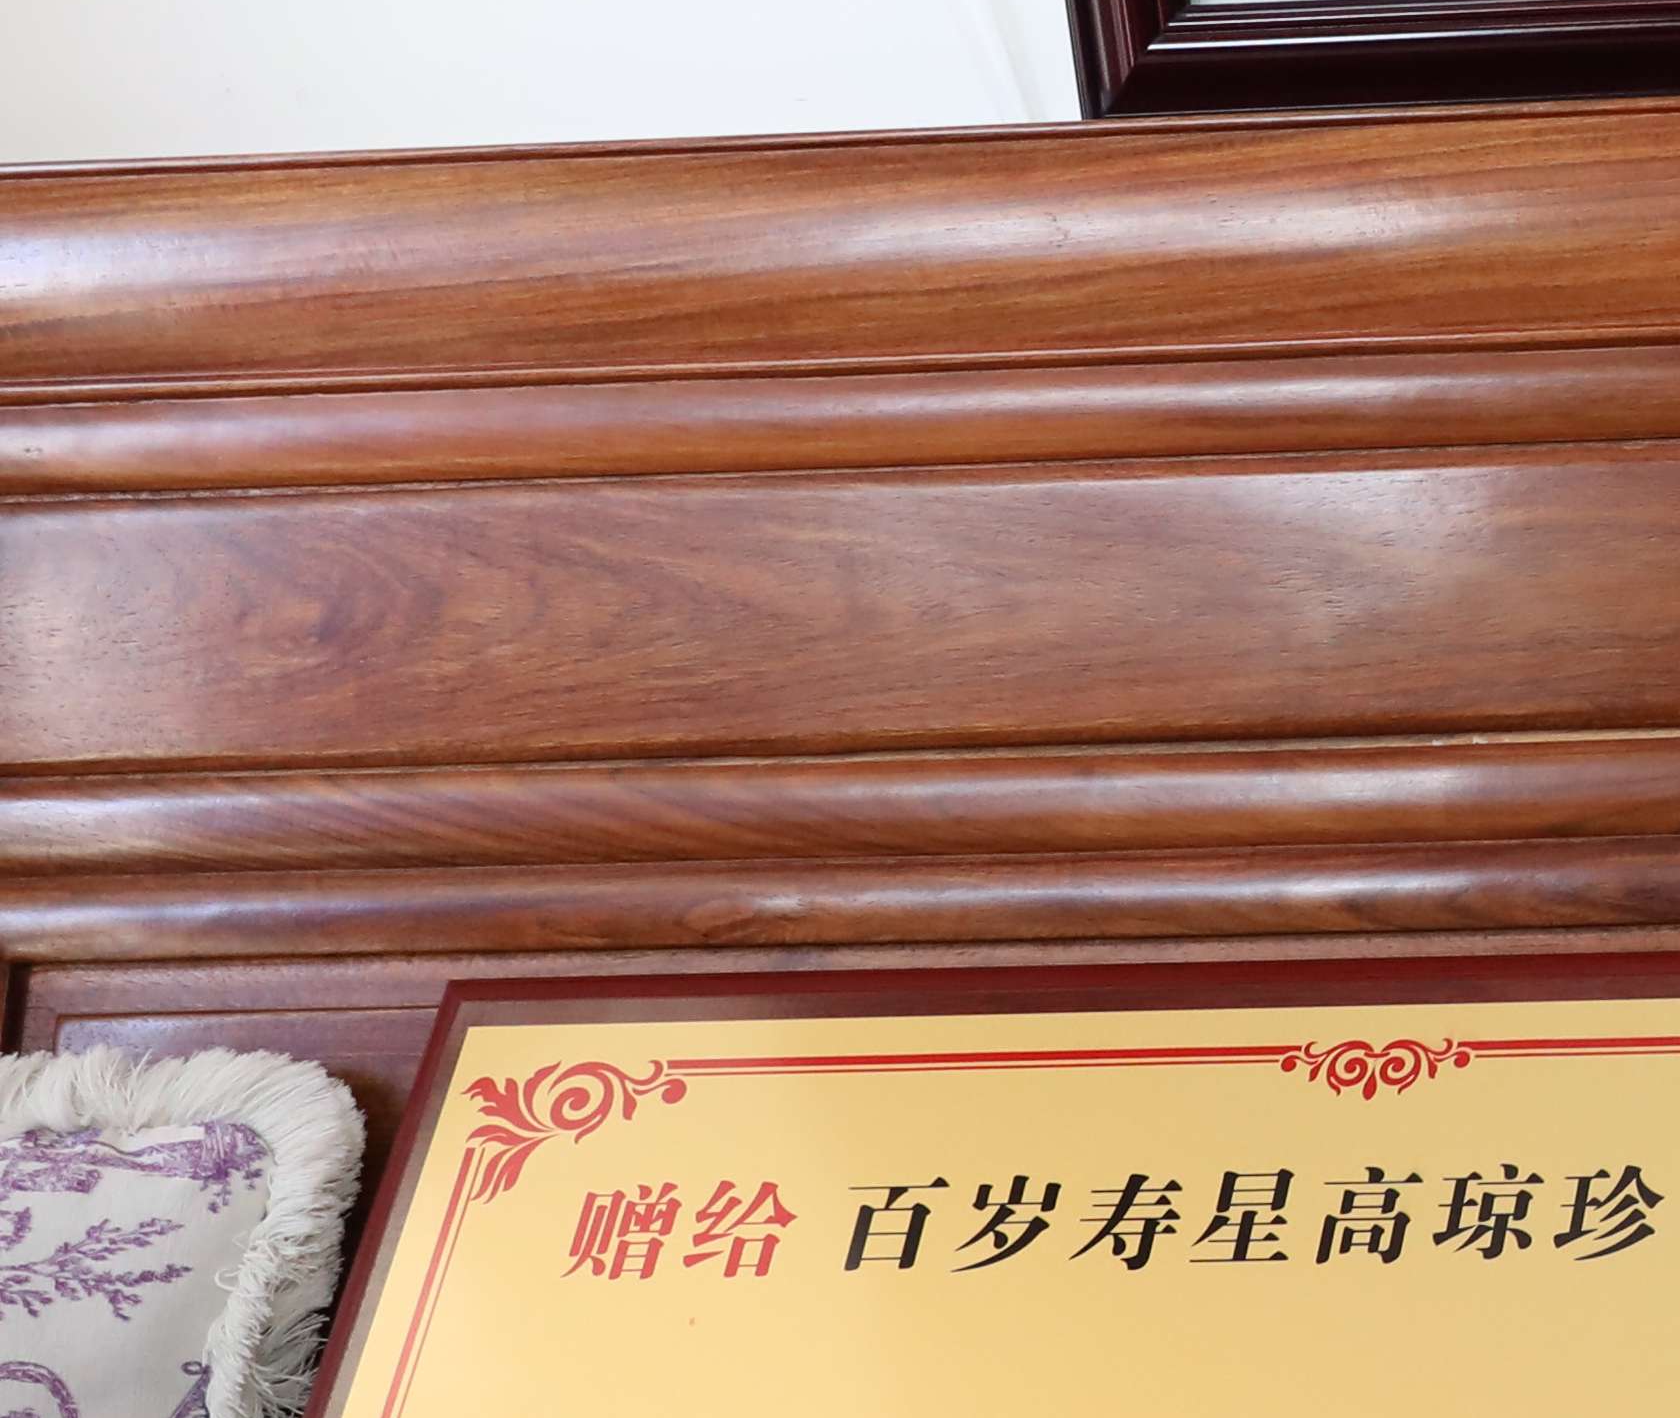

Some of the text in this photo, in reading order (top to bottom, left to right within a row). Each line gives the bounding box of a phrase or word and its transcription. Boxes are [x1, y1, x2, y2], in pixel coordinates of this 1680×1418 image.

[560, 1165, 1667, 1280] 赠给 百岁寿星高琼珍
